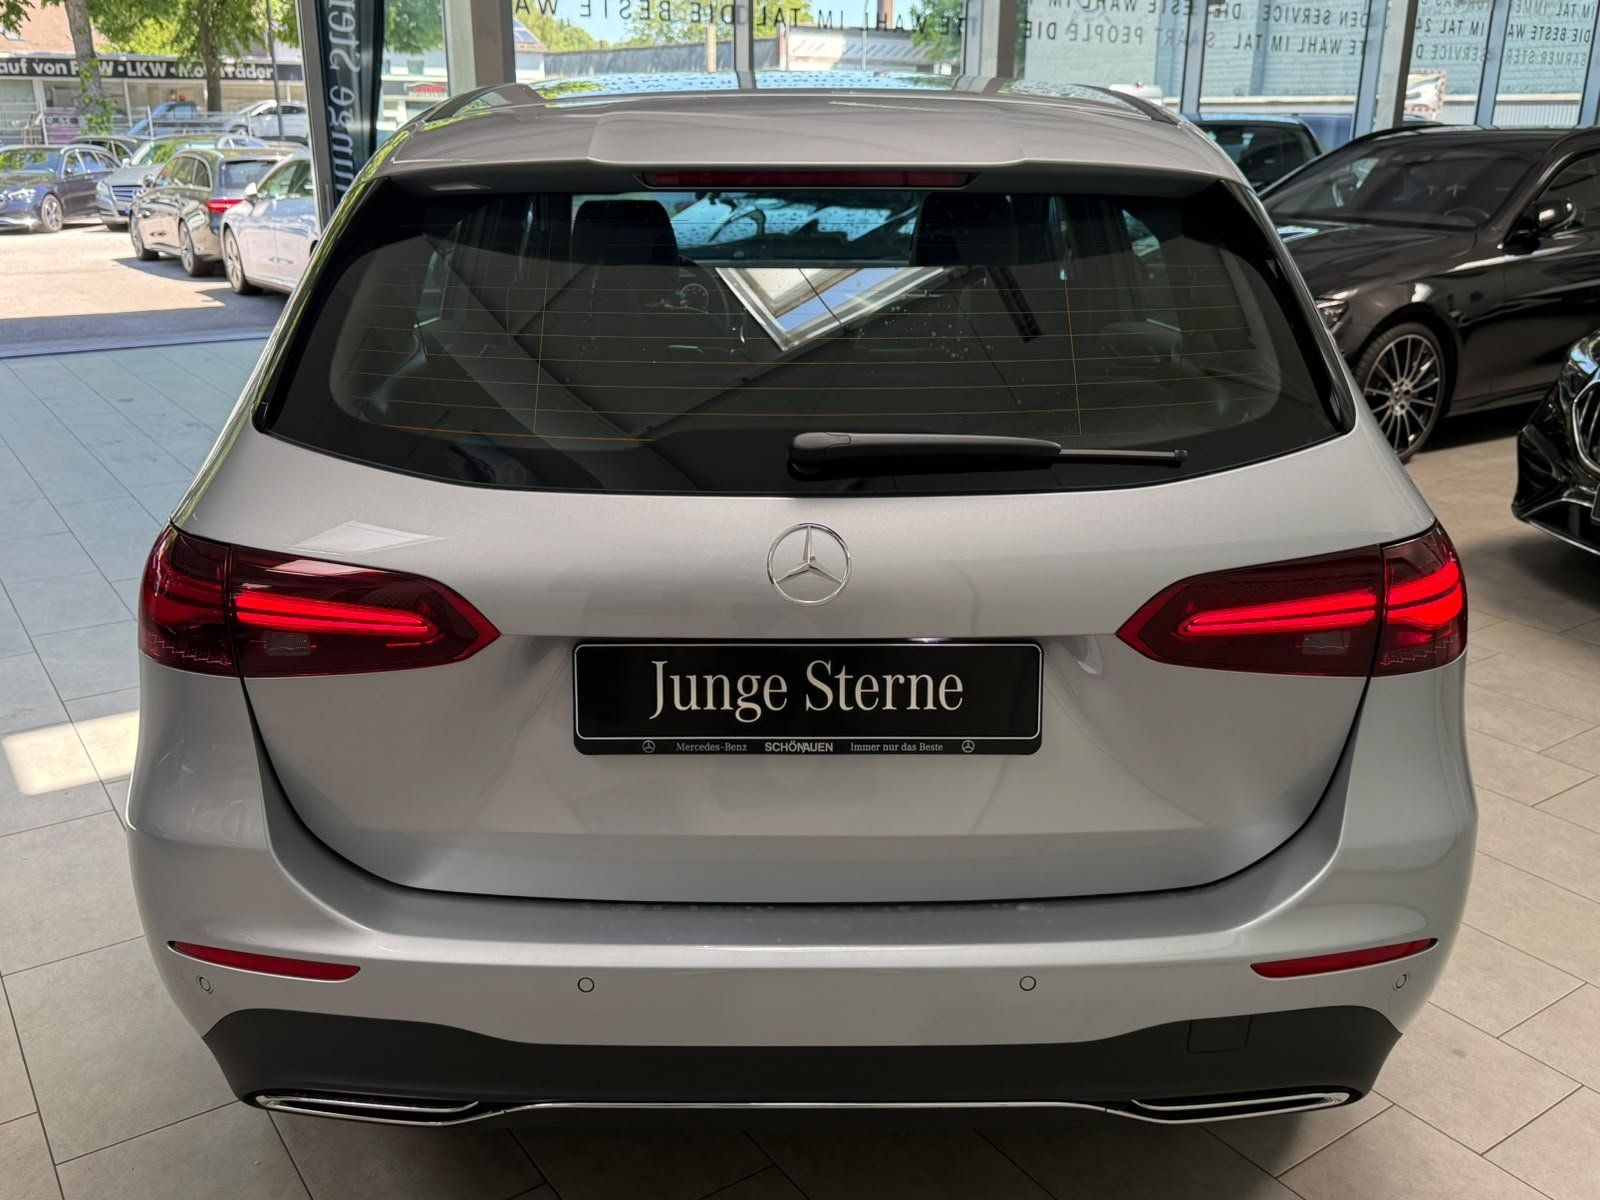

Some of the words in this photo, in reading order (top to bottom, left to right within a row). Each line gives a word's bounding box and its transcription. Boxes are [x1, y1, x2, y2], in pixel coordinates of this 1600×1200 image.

[32, 60, 67, 76] von
[70, 60, 116, 78] PW
[126, 59, 166, 79] LKW
[648, 660, 788, 723] Junge
[804, 659, 964, 712] Sterne
[676, 741, 748, 752] Mercedes-Benz
[764, 740, 834, 753] SCHÖNAUEN
[849, 742, 881, 752] Immer
[882, 744, 899, 752] nur
[901, 742, 917, 752] das
[919, 742, 944, 752] Beste
